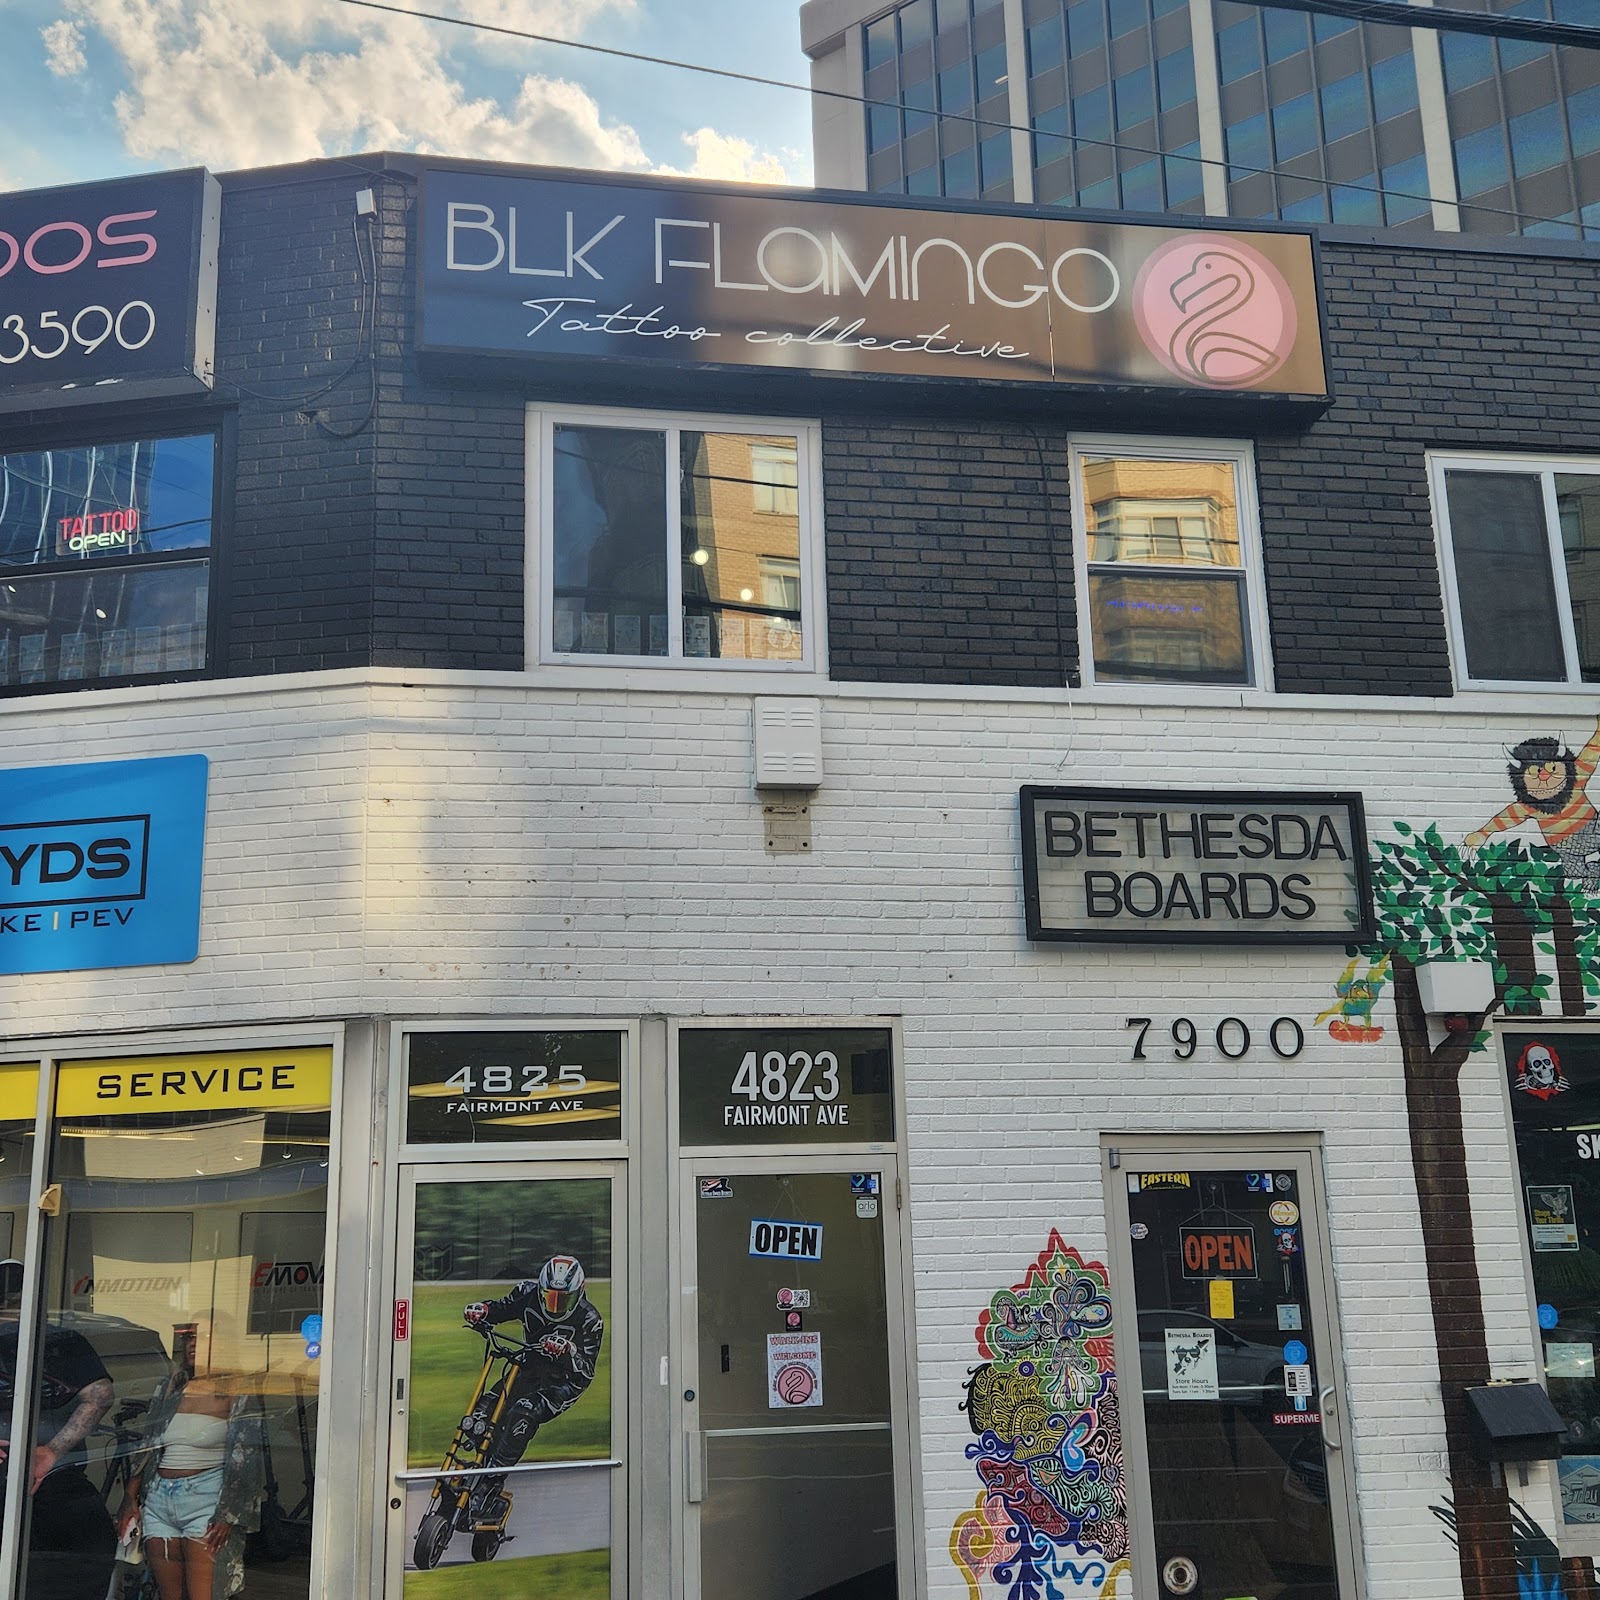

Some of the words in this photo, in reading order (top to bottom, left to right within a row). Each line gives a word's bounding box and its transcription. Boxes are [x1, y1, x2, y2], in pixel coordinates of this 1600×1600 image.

[0, 209, 158, 277] OS
[446, 201, 626, 280] BLK
[654, 217, 1121, 314] FLAMINGO
[0, 300, 156, 364] 3590
[522, 297, 721, 341] Tattoo
[745, 317, 1030, 359] collective
[59, 508, 137, 541] TATTOO
[69, 530, 126, 551] OPEN
[1044, 810, 1348, 861] BETHESDA
[0, 837, 132, 886] YDS
[1084, 870, 1317, 920] BOARDS
[0, 913, 42, 933] KE
[70, 907, 134, 929] PEV
[1125, 1017, 1304, 1060] 7900
[96, 1065, 296, 1099] SERVICE
[444, 1064, 587, 1093] 4825
[730, 1050, 840, 1102] 4823
[446, 1101, 543, 1114] FAIRMONT
[548, 1100, 584, 1112] AVE
[723, 1105, 809, 1126] FAIRMONT
[816, 1104, 849, 1126] AVE
[1141, 1172, 1191, 1190] EASTERN
[858, 1201, 875, 1210] arlo
[754, 1222, 818, 1257] OPEN
[1183, 1234, 1253, 1271] OPEN
[398, 1302, 406, 1338] PULL
[773, 1351, 817, 1360] WELCOME
[1274, 1413, 1320, 1424] SUPERME
[1586, 1512, 1595, 1520] 64
